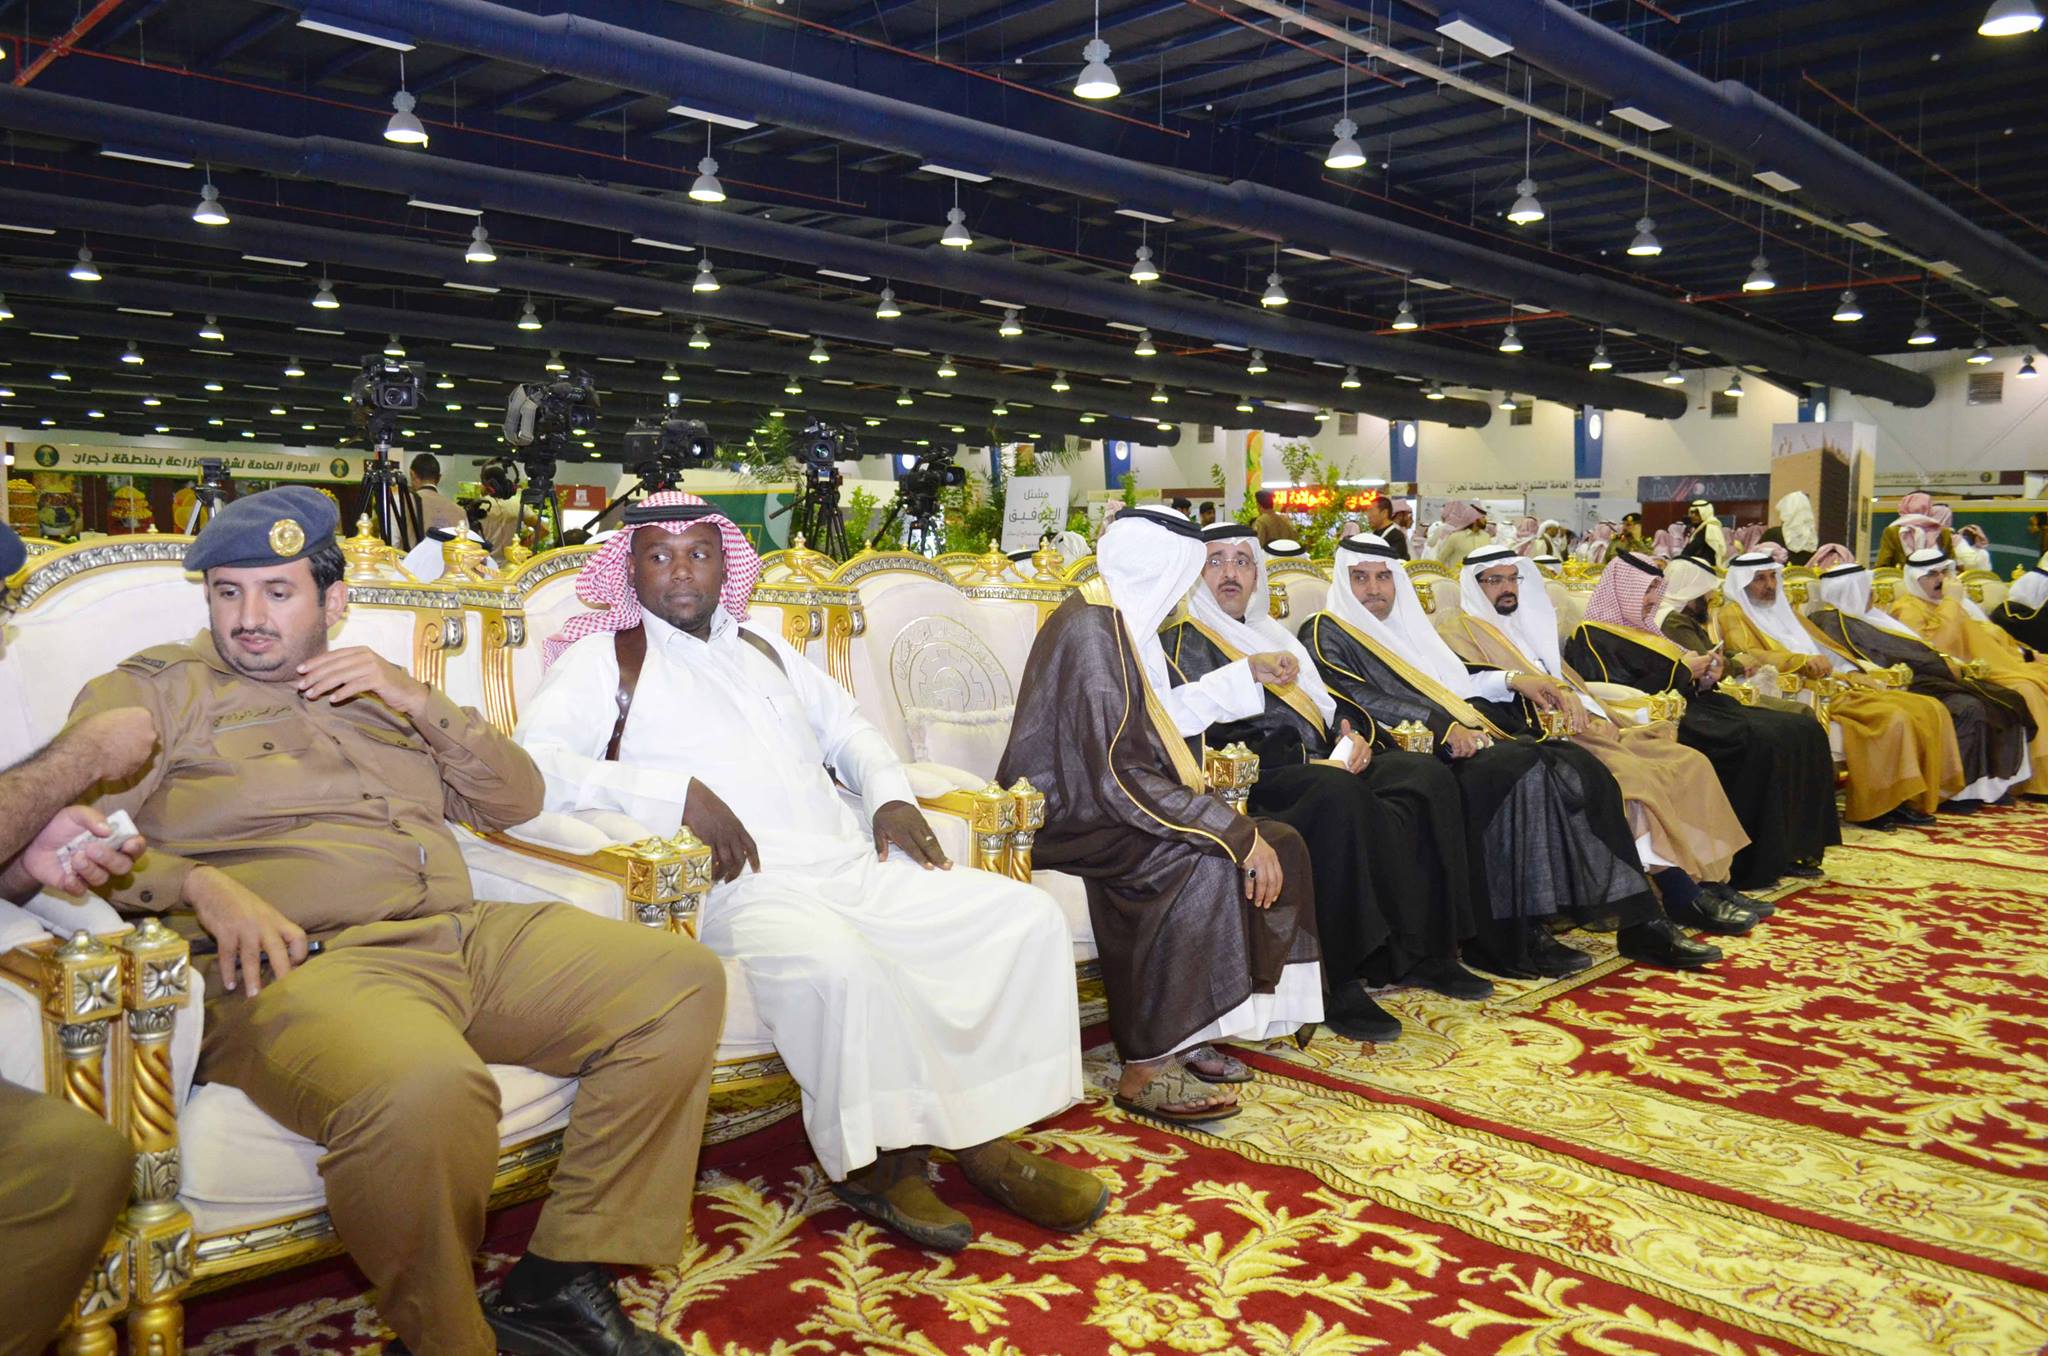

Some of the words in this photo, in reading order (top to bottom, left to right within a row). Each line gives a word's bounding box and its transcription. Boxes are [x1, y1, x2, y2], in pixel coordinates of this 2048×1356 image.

[72, 452, 109, 465] نجران
[112, 453, 163, 468] بمنطقة
[247, 459, 284, 470] العامة
[285, 461, 320, 473] الإدارة
[1023, 488, 1049, 500] مشتل
